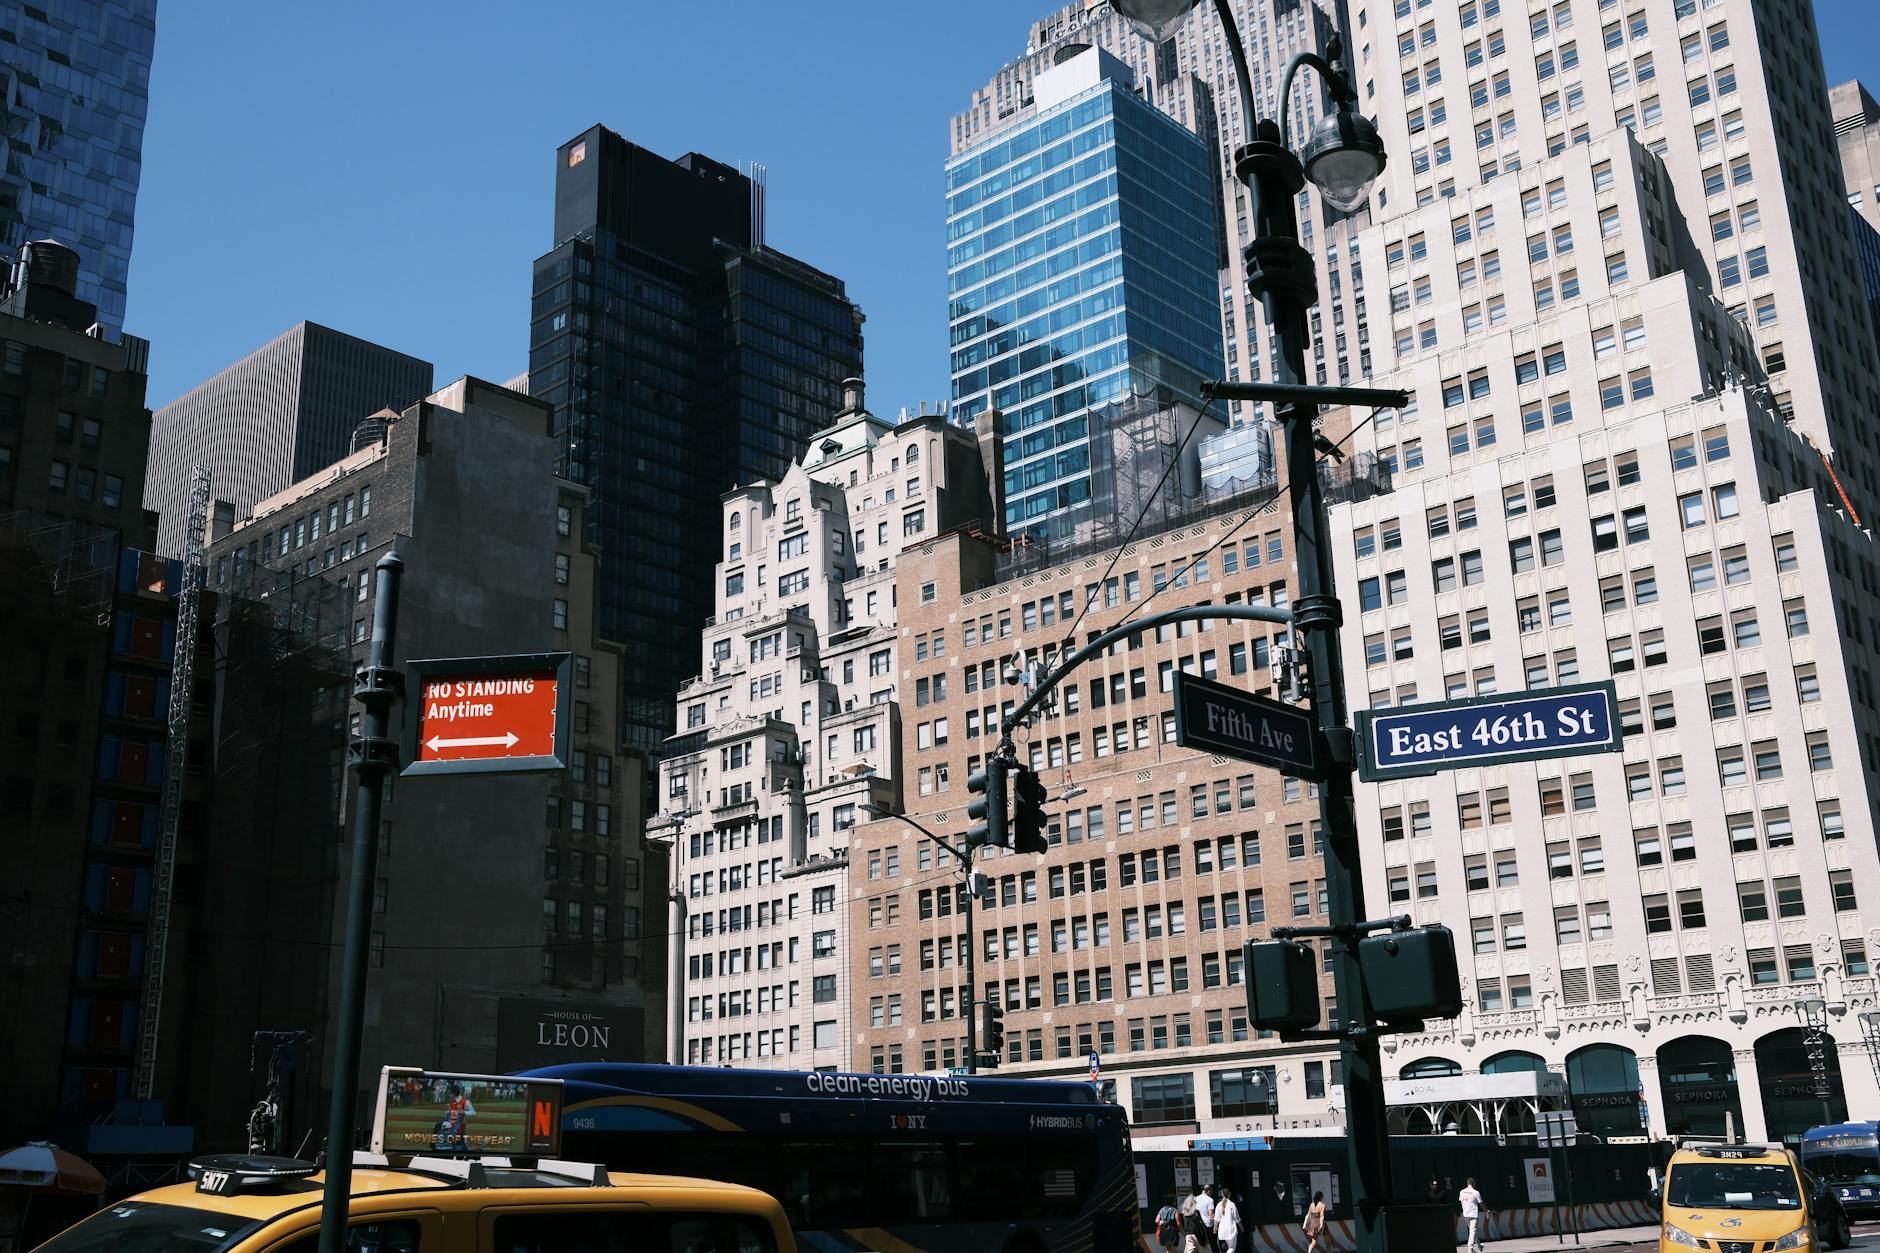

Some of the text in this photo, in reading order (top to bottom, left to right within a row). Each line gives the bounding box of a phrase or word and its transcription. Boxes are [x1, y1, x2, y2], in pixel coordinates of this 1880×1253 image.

[429, 678, 534, 698] NO STANDING
[428, 701, 493, 721] Anytime
[1206, 702, 1294, 752] Fifth Ave
[1388, 706, 1596, 757] East 46th St
[554, 1011, 580, 1020] HOUSE
[537, 1022, 611, 1048] LEON
[807, 1072, 969, 1100] clean-energy bus
[1675, 1090, 1728, 1102] SEPHORA
[1582, 1096, 1631, 1107] SEPHORA
[534, 1101, 552, 1136] N
[573, 1118, 595, 1129] 9436
[906, 1115, 926, 1129] NY
[404, 1133, 444, 1143] MOVIES
[447, 1134, 461, 1144] OF
